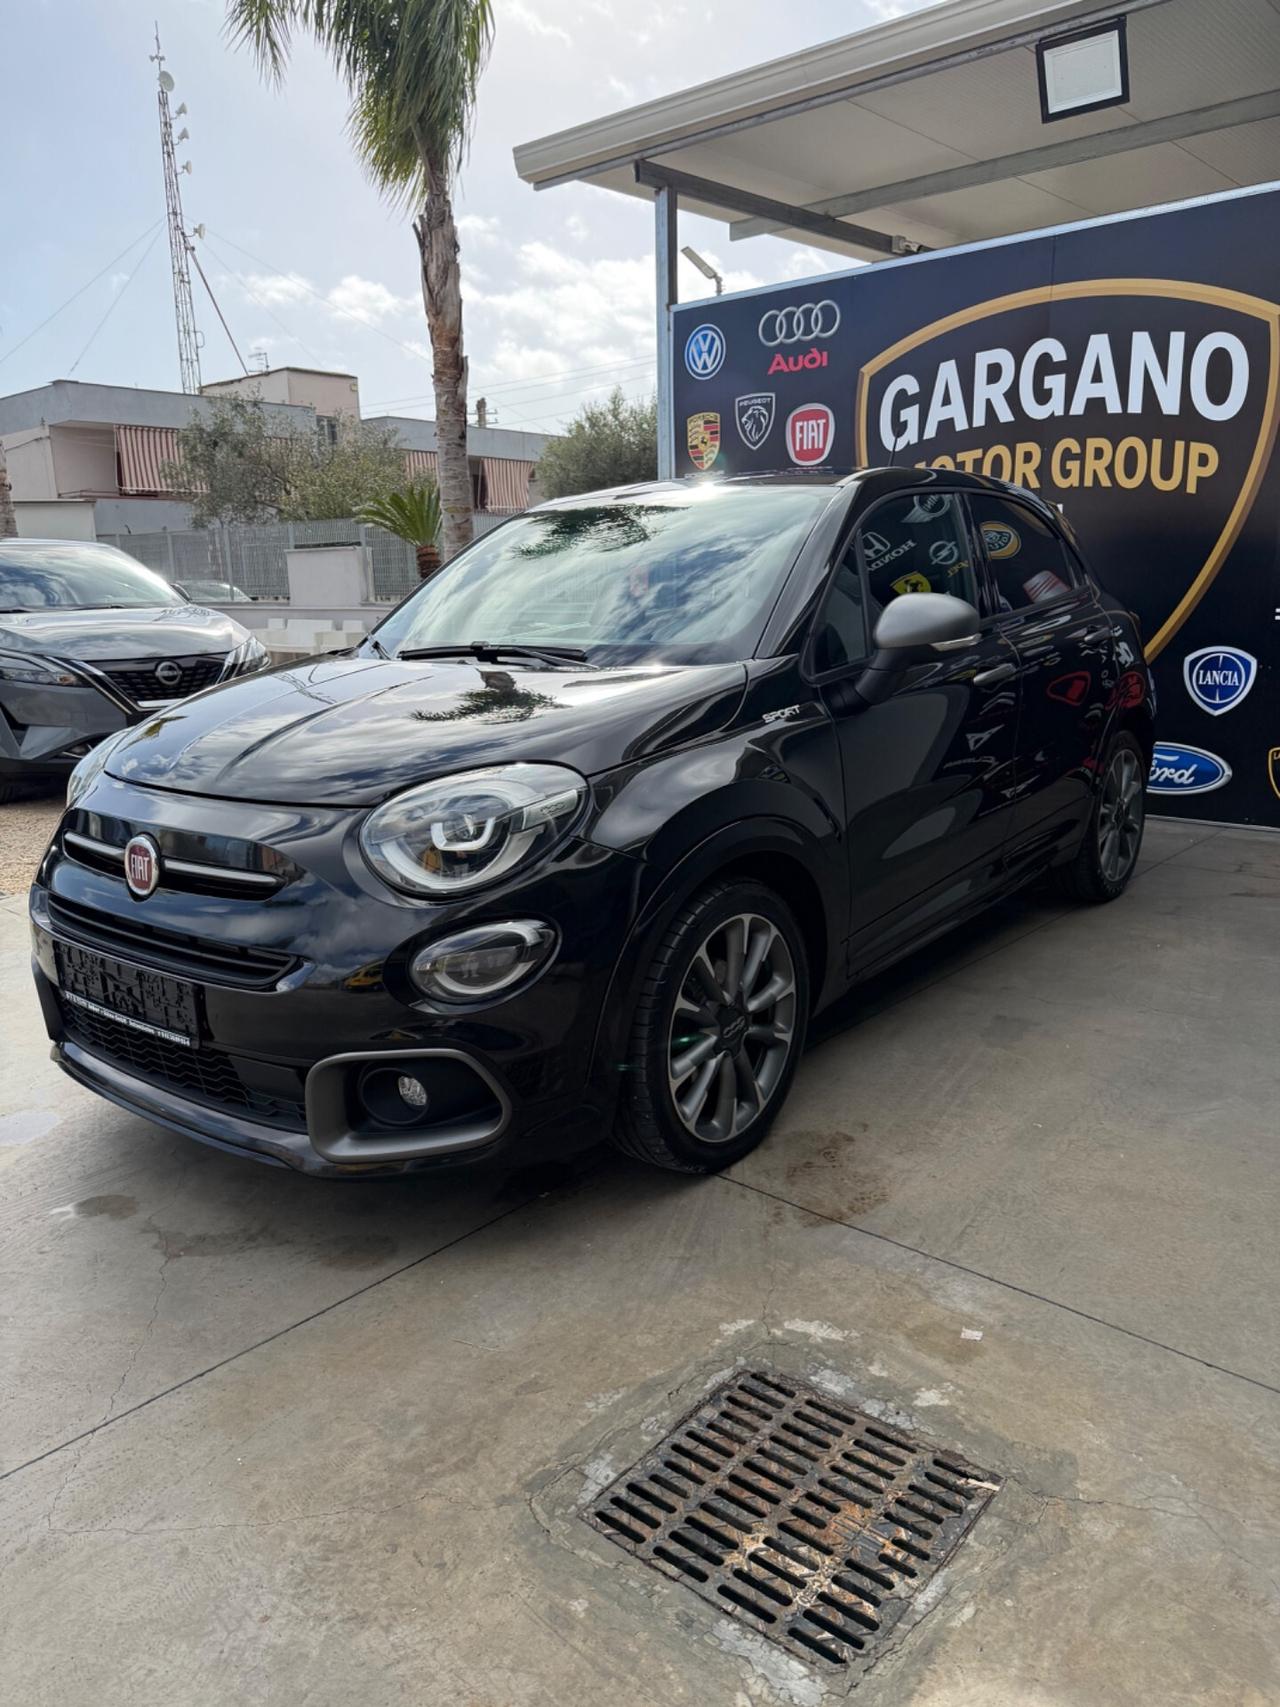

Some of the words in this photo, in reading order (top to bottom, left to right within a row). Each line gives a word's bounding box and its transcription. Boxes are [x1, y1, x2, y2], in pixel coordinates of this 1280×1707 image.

[767, 347, 829, 375] Audi
[879, 330, 1250, 452] GARGANO
[795, 419, 827, 451] FIAT
[914, 441, 1042, 489] TOR
[1051, 436, 1220, 495] GROUP
[1198, 669, 1240, 687] LANCIA
[761, 704, 801, 723] SPORT
[130, 852, 151, 883] FIAT
